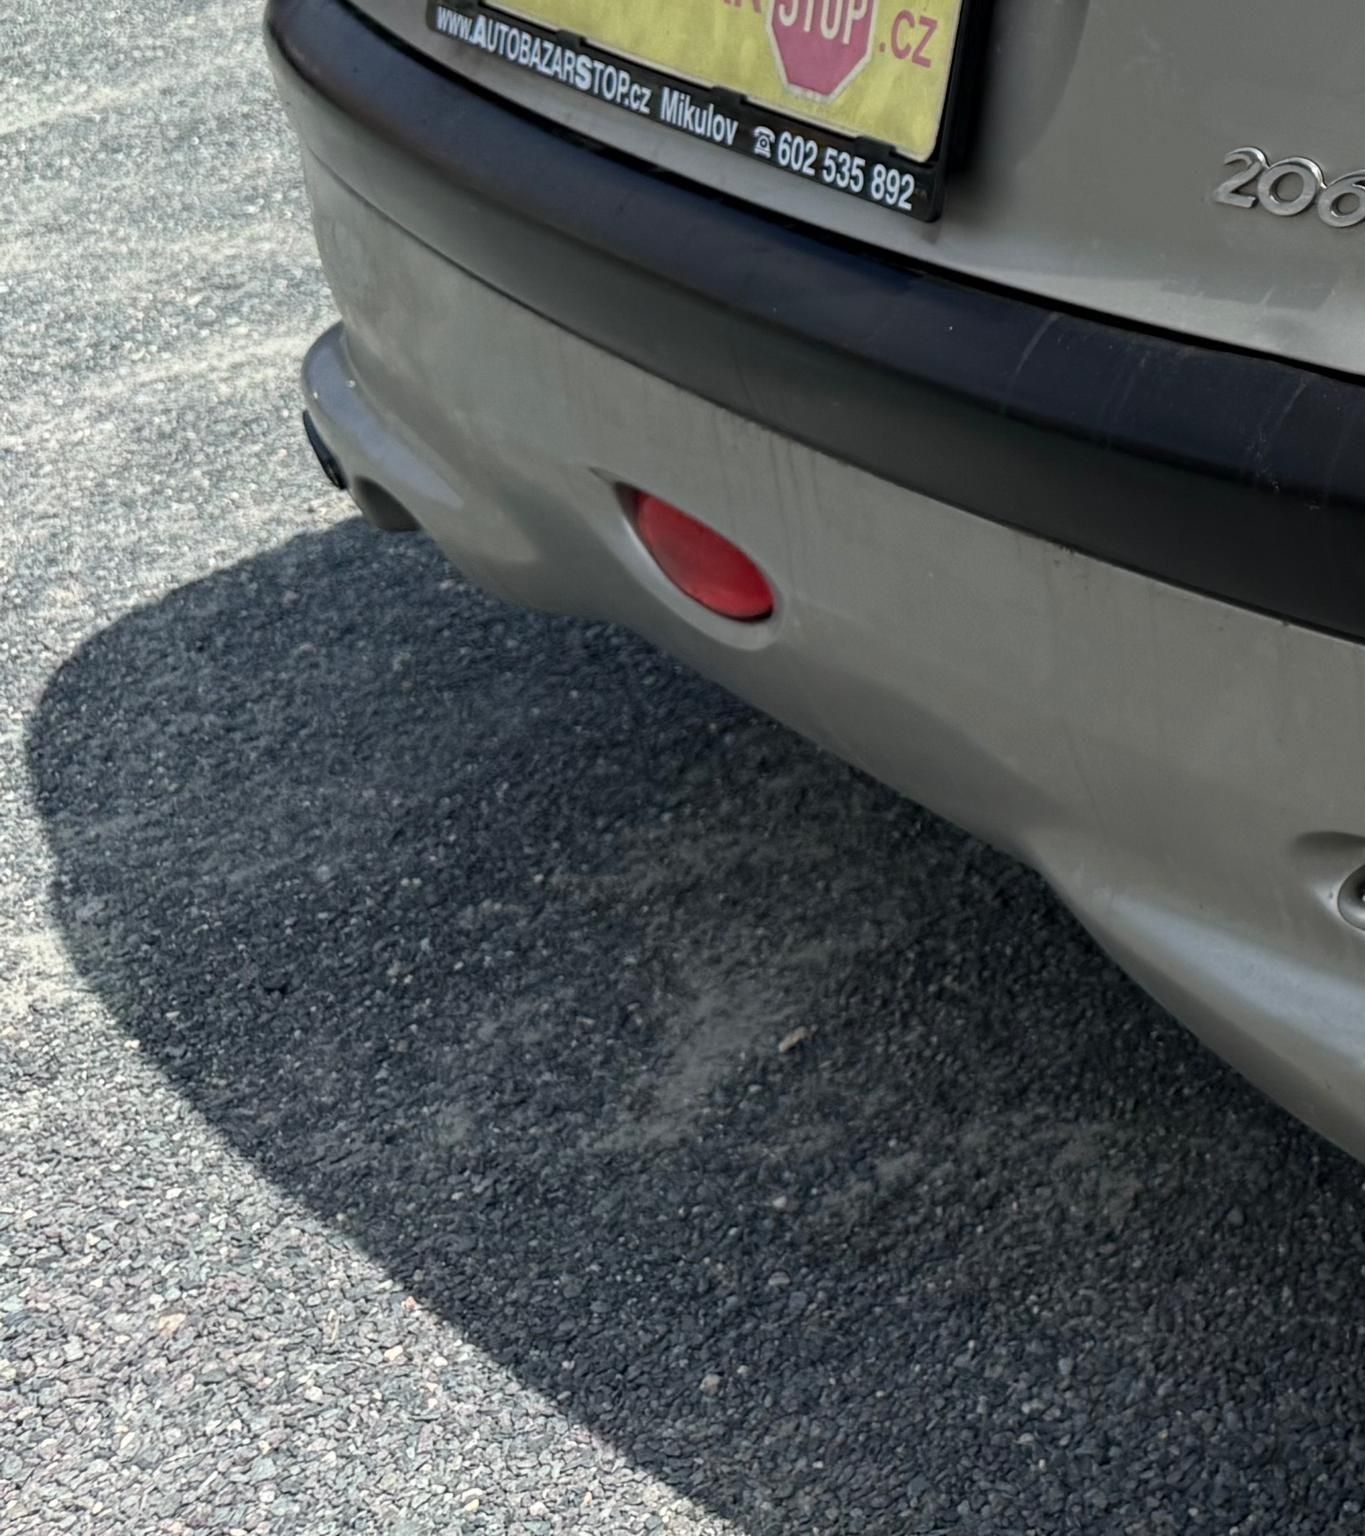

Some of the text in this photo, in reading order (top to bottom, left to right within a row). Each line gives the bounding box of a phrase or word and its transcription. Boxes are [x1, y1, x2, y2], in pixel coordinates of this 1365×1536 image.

[660, 87, 739, 146] Mikulov
[777, 131, 819, 176] 602
[822, 147, 866, 193] 535
[871, 163, 916, 210] 892
